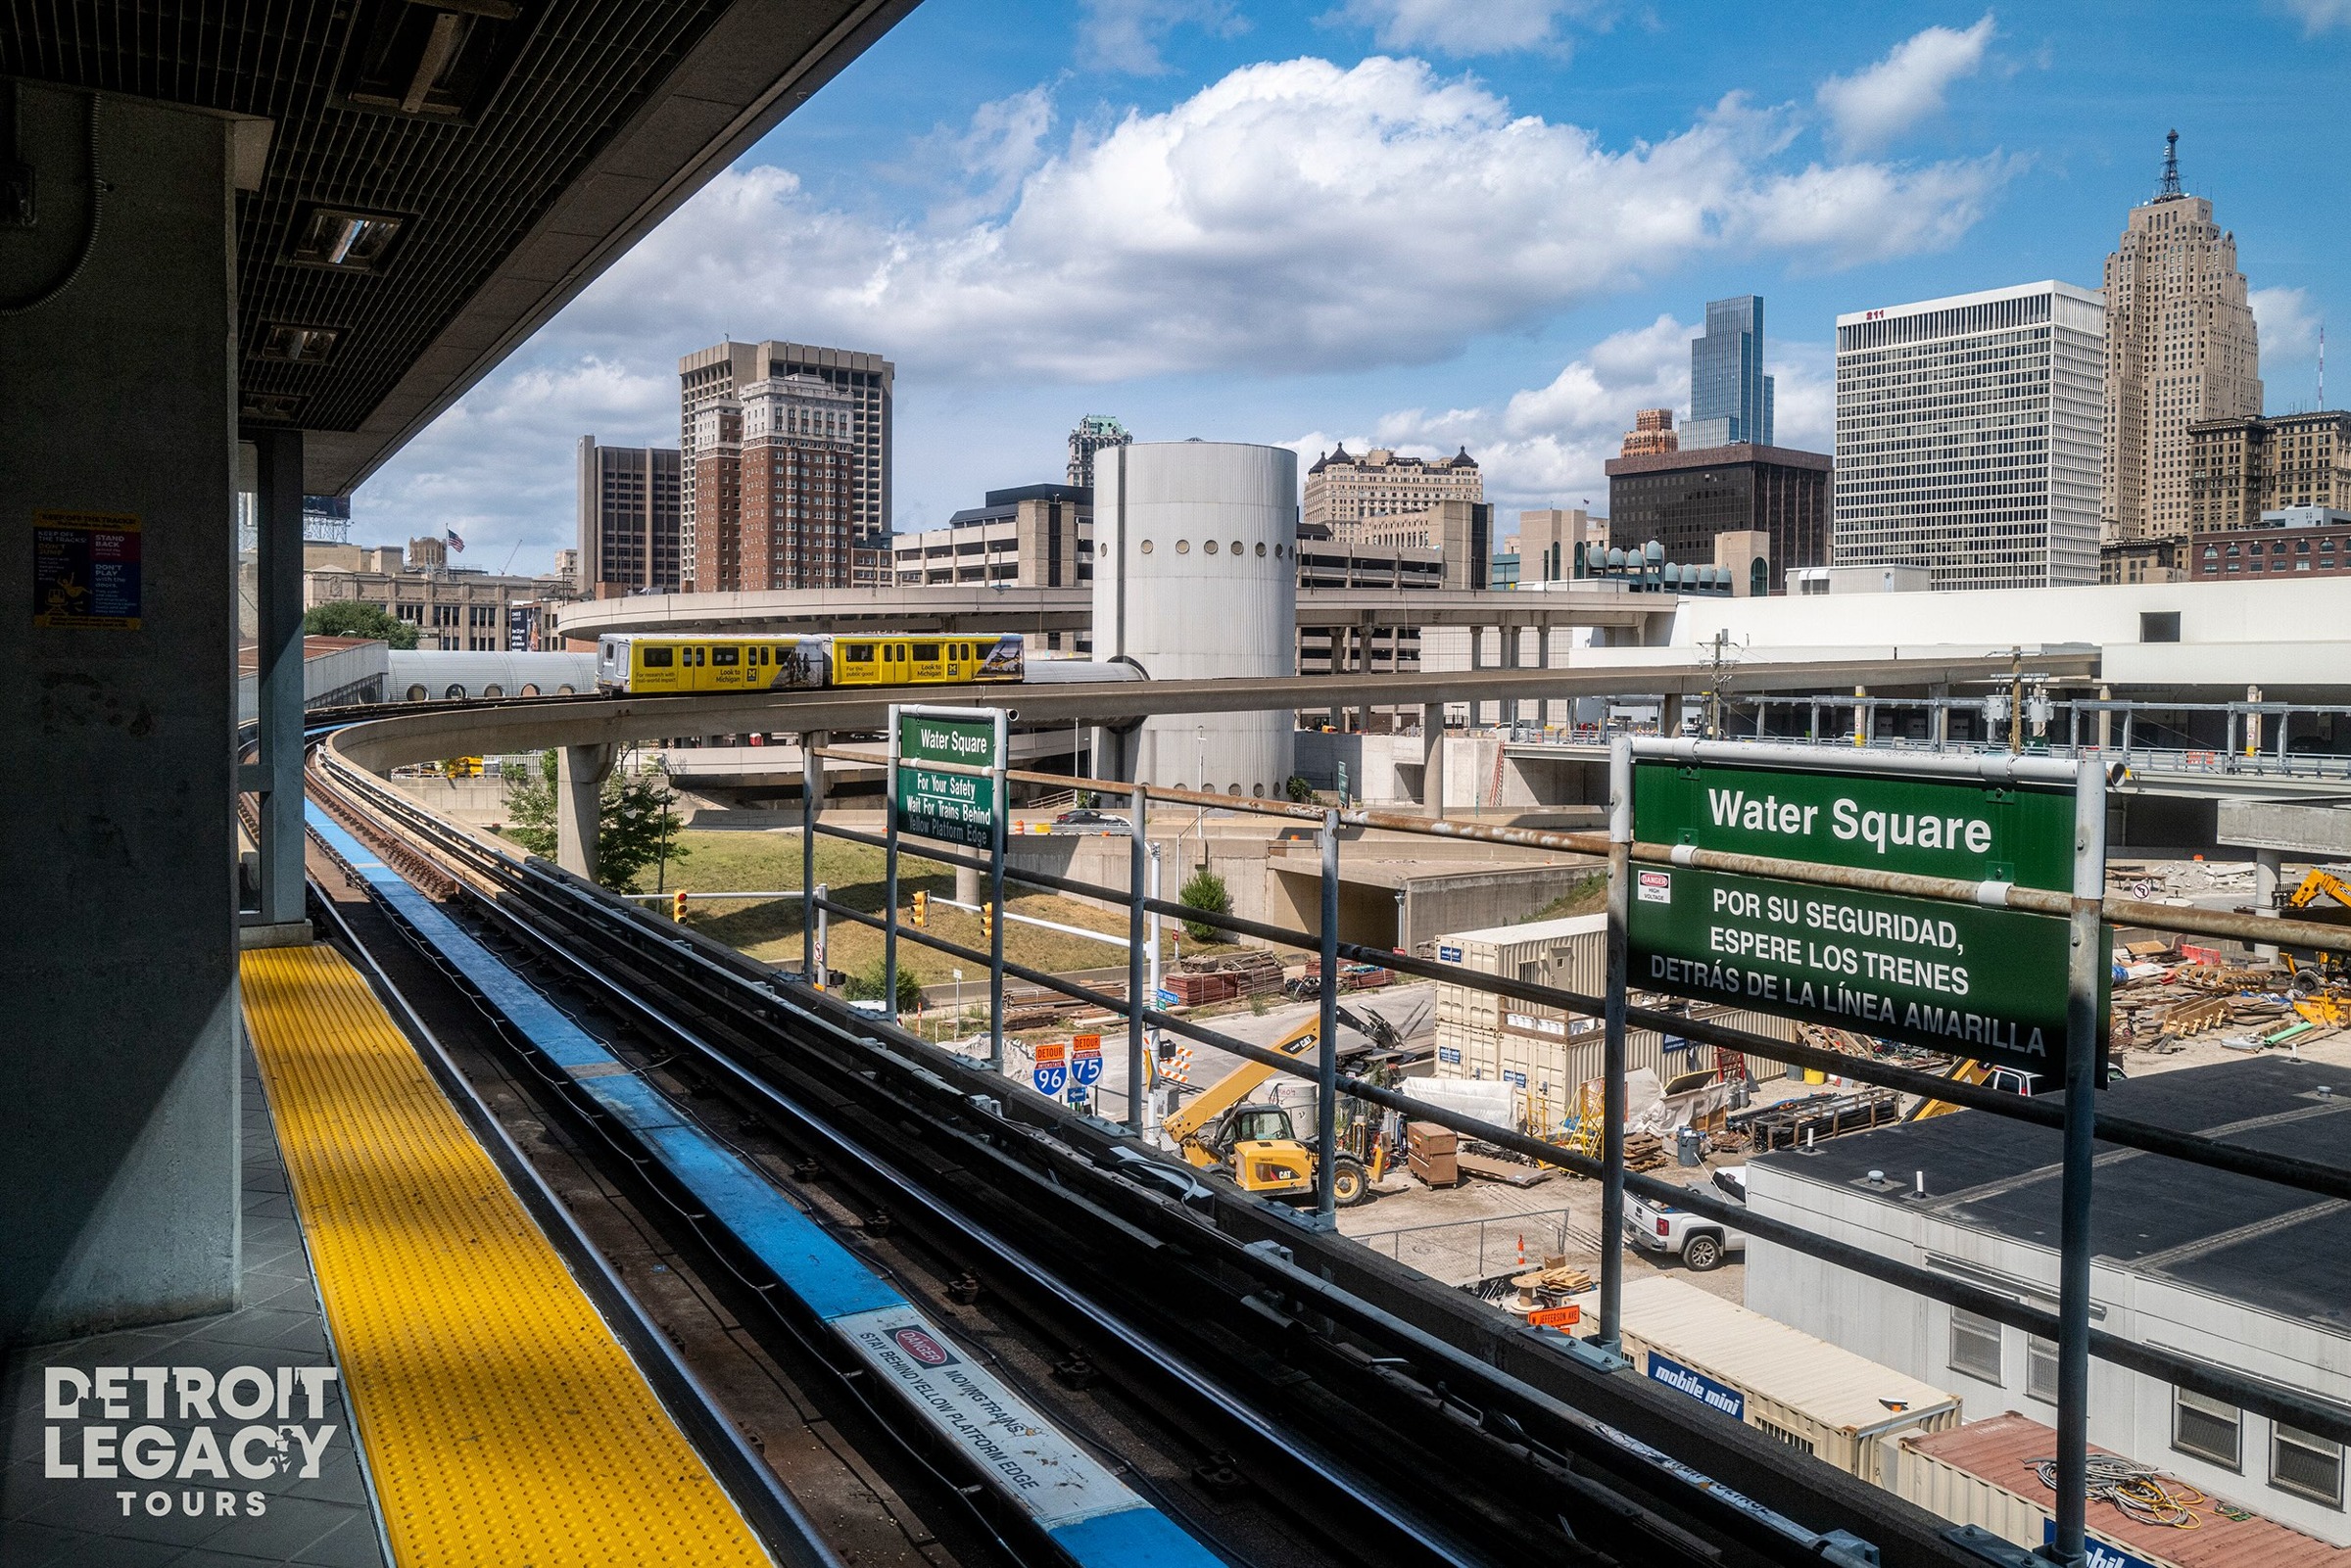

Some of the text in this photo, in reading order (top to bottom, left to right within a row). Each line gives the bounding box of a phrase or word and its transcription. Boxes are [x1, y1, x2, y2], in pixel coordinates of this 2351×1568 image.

[1866, 309, 1884, 320] 211
[921, 729, 987, 756] Water Square
[917, 773, 976, 800] For Your Safety
[906, 795, 990, 826] Wait For Trains Behind
[1707, 788, 1992, 854] Water Square
[909, 814, 987, 847] Yellow Platform Edge
[1641, 876, 1666, 885] DANGER
[1712, 889, 1964, 956] POR SU SEGURIDAD,
[1710, 927, 1970, 996] ESPERE LOS TRENES
[1651, 954, 2046, 1058] DETRÁS DE LA LÍNEA AMARILLA
[1038, 1047, 1063, 1059] DETOUR
[1075, 1037, 1098, 1048] DETOUR
[1300, 1035, 1312, 1048] CAT
[1038, 1069, 1062, 1089] 96
[1074, 1059, 1100, 1079] 75
[1278, 1170, 1291, 1180] CAT
[1539, 1310, 1566, 1324] JEFFERSON
[1568, 1309, 1577, 1320] AVE
[900, 1332, 941, 1362] DANGER
[943, 1370, 1024, 1433] MOVING TRAINS
[1655, 1365, 1740, 1416] mobile mini
[859, 1332, 1039, 1490] STAY BEHIND YELLOW PLATFORM EDGE
